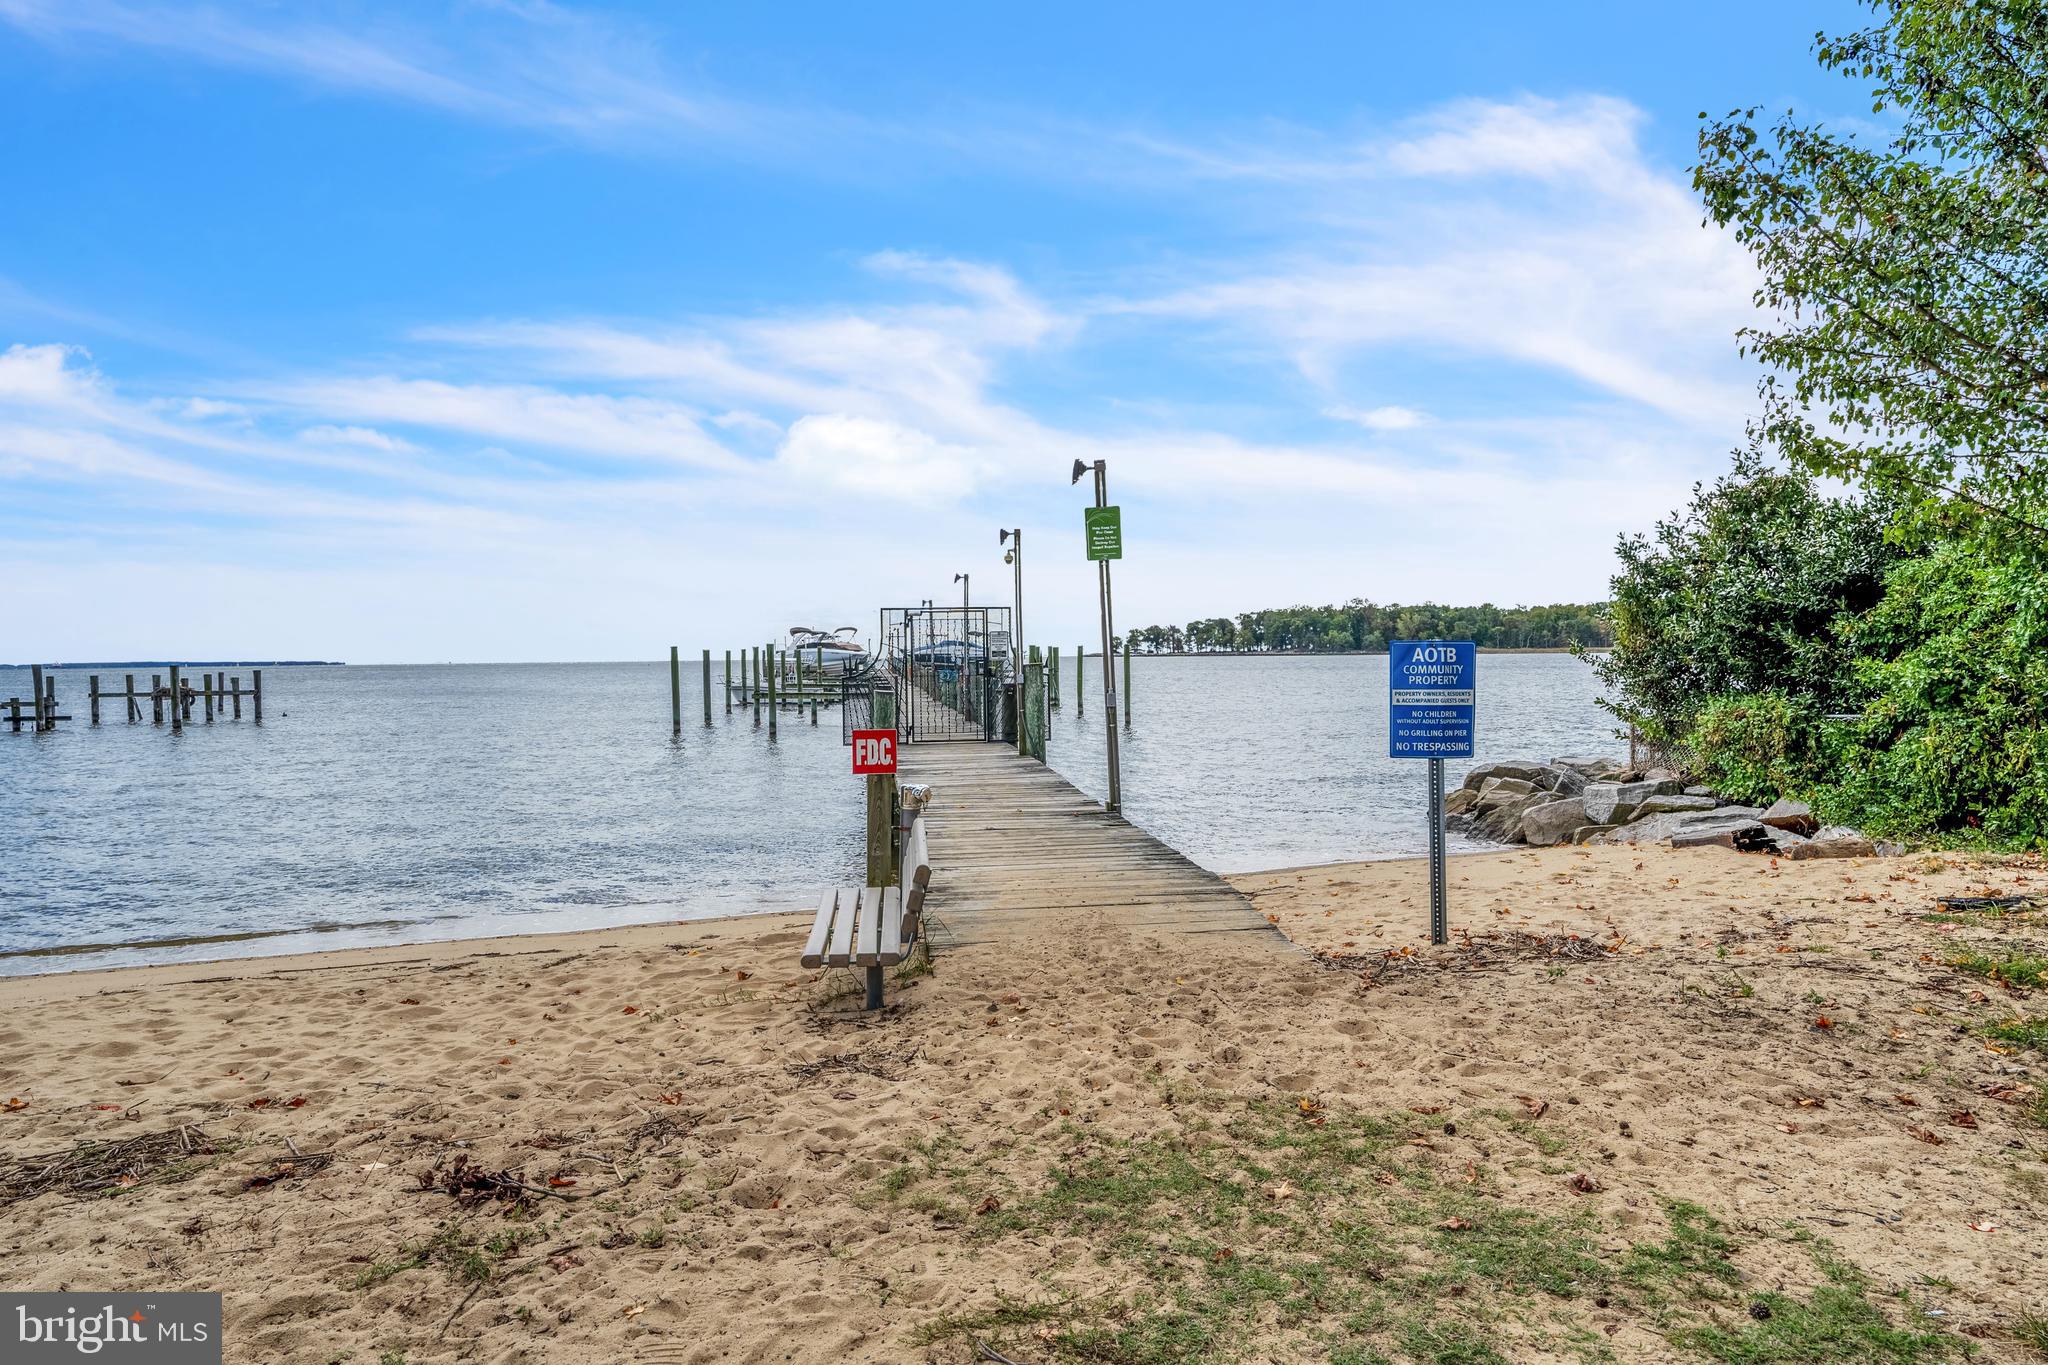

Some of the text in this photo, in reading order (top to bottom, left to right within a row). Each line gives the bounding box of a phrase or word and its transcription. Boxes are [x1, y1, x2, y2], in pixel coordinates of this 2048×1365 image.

[1412, 647, 1456, 662] AOTB
[1403, 665, 1464, 674] COMMUNITY
[1409, 676, 1458, 685] PROPERTY
[1396, 742, 1469, 750] NO TRESPASSING
